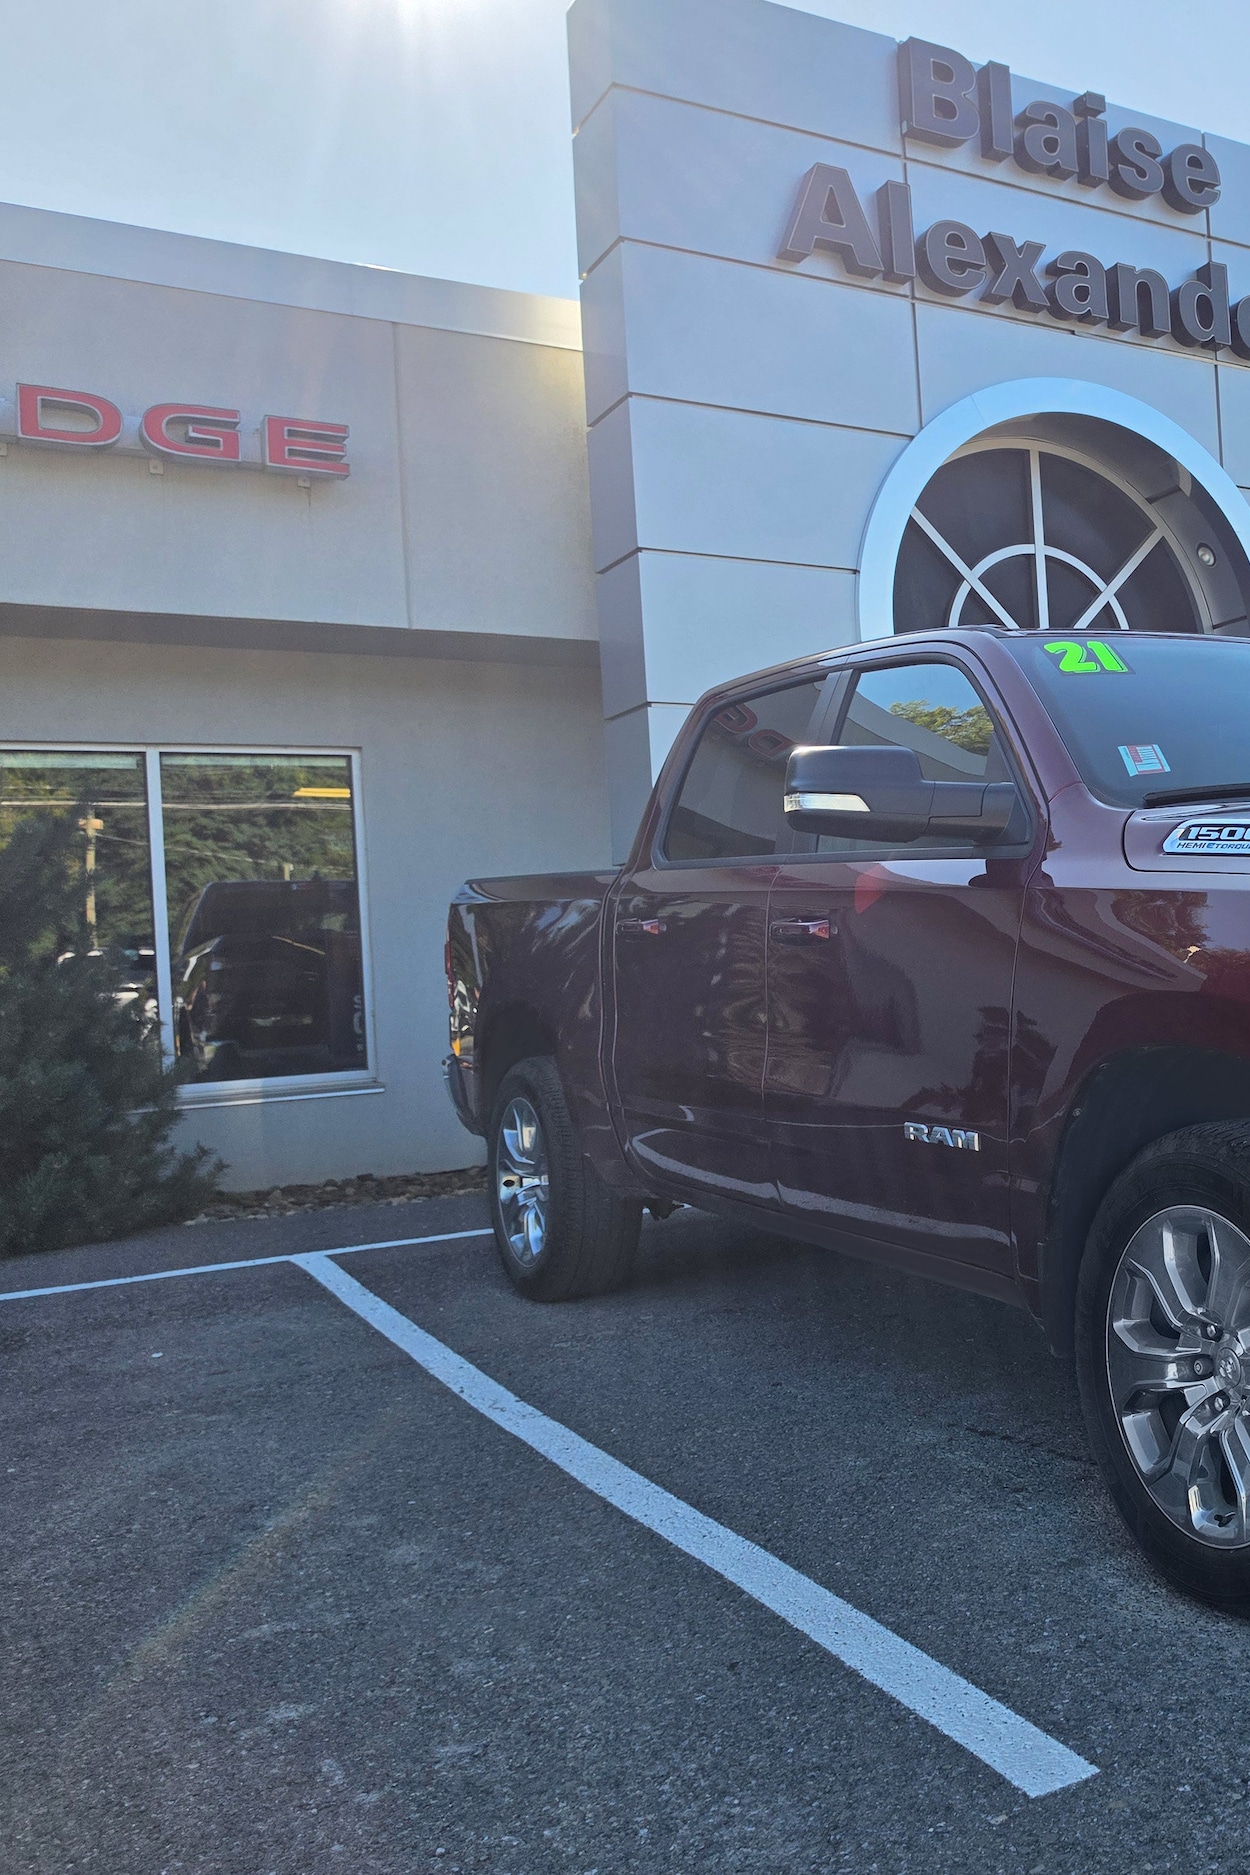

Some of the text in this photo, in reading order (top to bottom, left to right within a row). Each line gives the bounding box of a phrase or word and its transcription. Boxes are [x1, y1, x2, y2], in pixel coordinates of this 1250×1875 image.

[901, 36, 1221, 215] Blaise
[1043, 640, 1129, 674] 21
[904, 1121, 980, 1152] RAM
